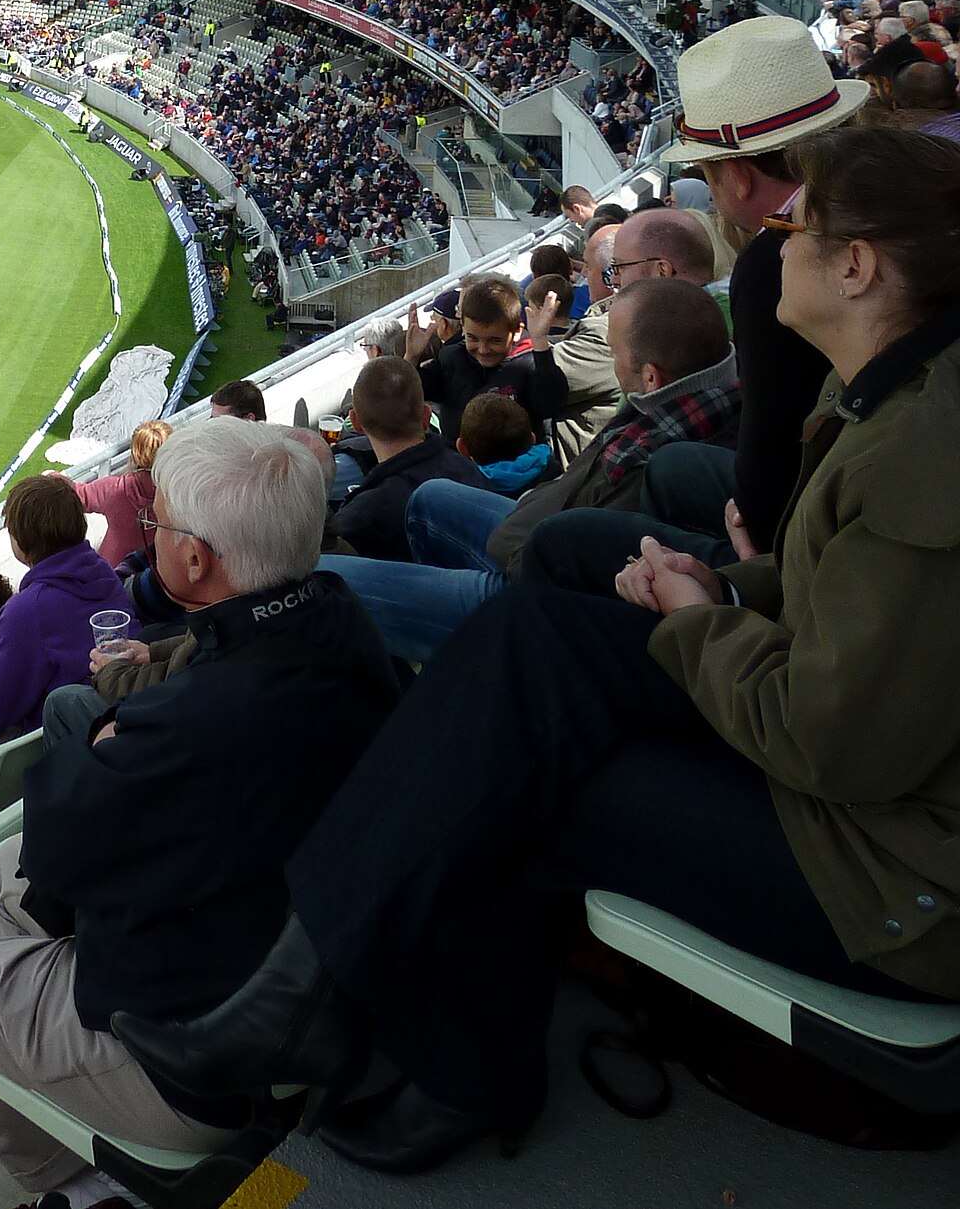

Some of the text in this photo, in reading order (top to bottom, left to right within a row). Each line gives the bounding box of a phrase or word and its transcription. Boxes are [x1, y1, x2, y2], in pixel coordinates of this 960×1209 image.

[45, 91, 69, 106] GROUP
[105, 134, 142, 165] JAGUAR
[190, 278, 209, 332] Investec
